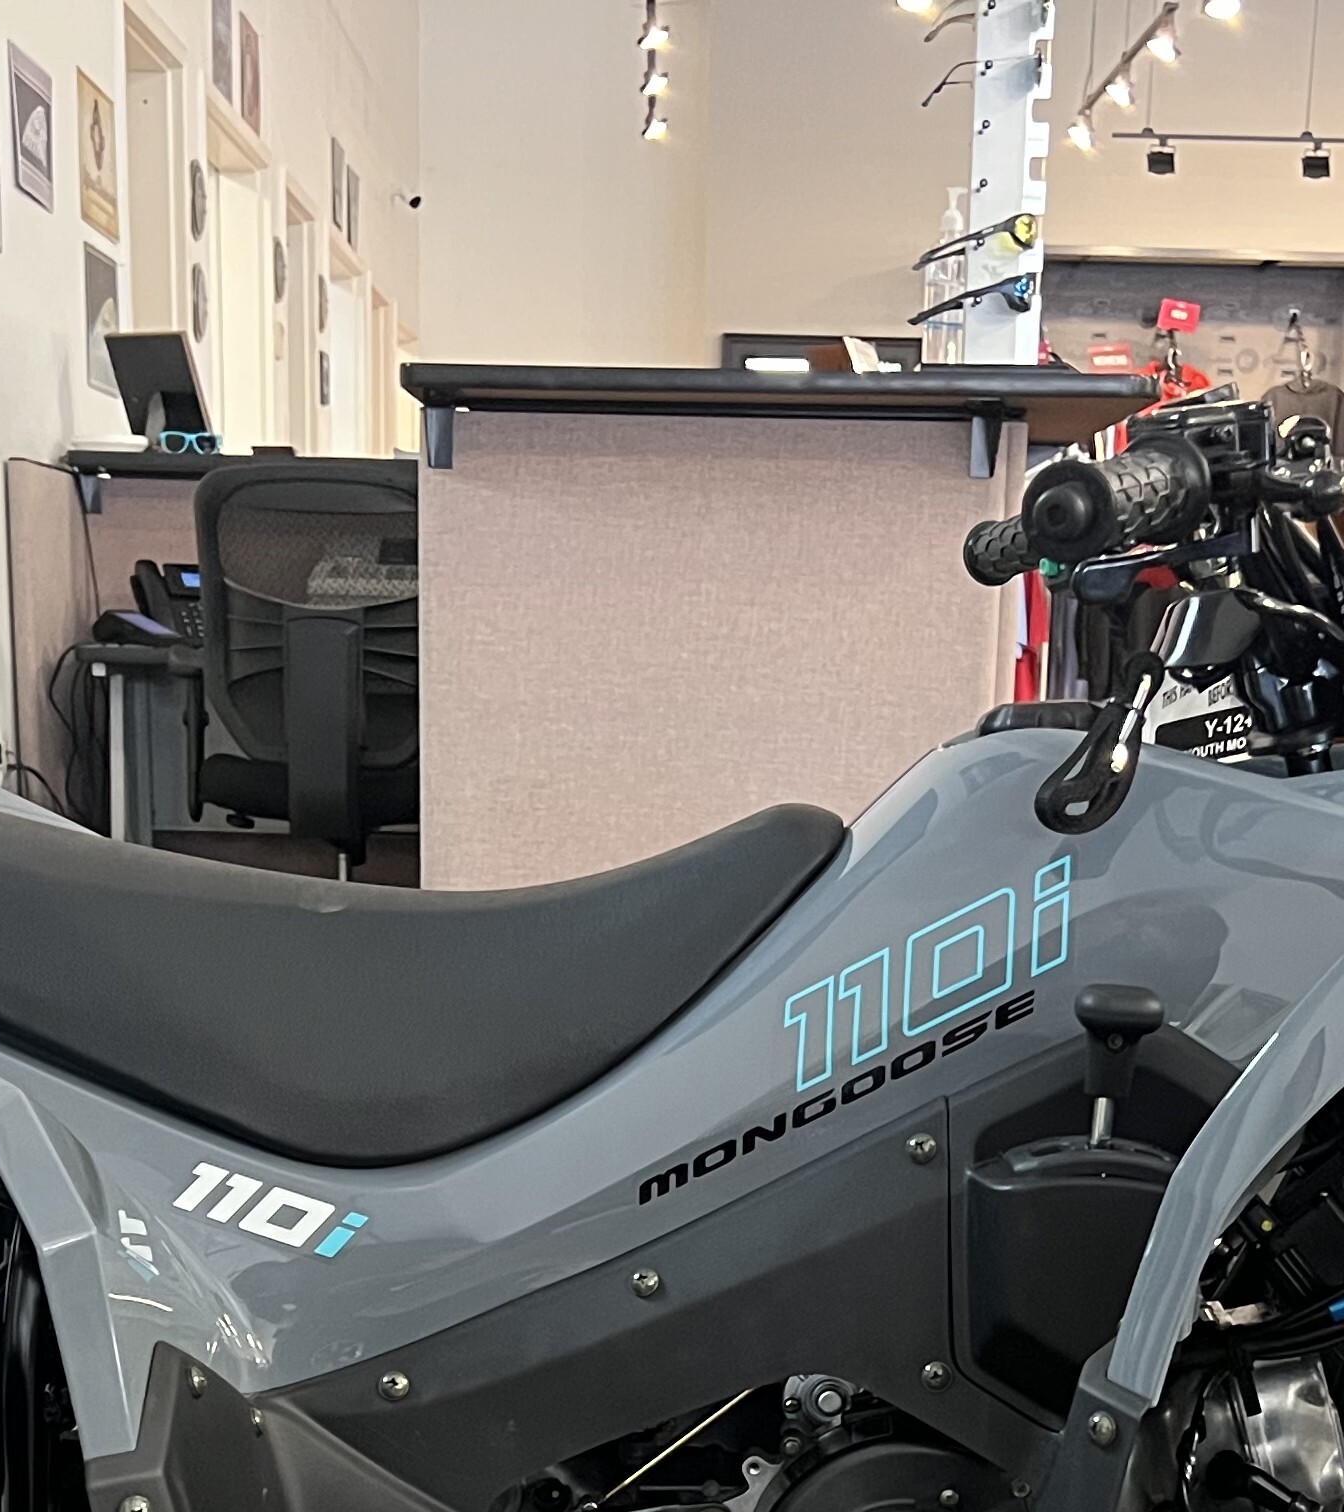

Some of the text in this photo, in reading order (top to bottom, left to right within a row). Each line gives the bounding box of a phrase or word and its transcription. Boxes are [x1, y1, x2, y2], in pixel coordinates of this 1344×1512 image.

[783, 854, 1072, 1093] 110i
[637, 988, 1036, 1207] MONGOOSE
[172, 1161, 370, 1259] 110i
